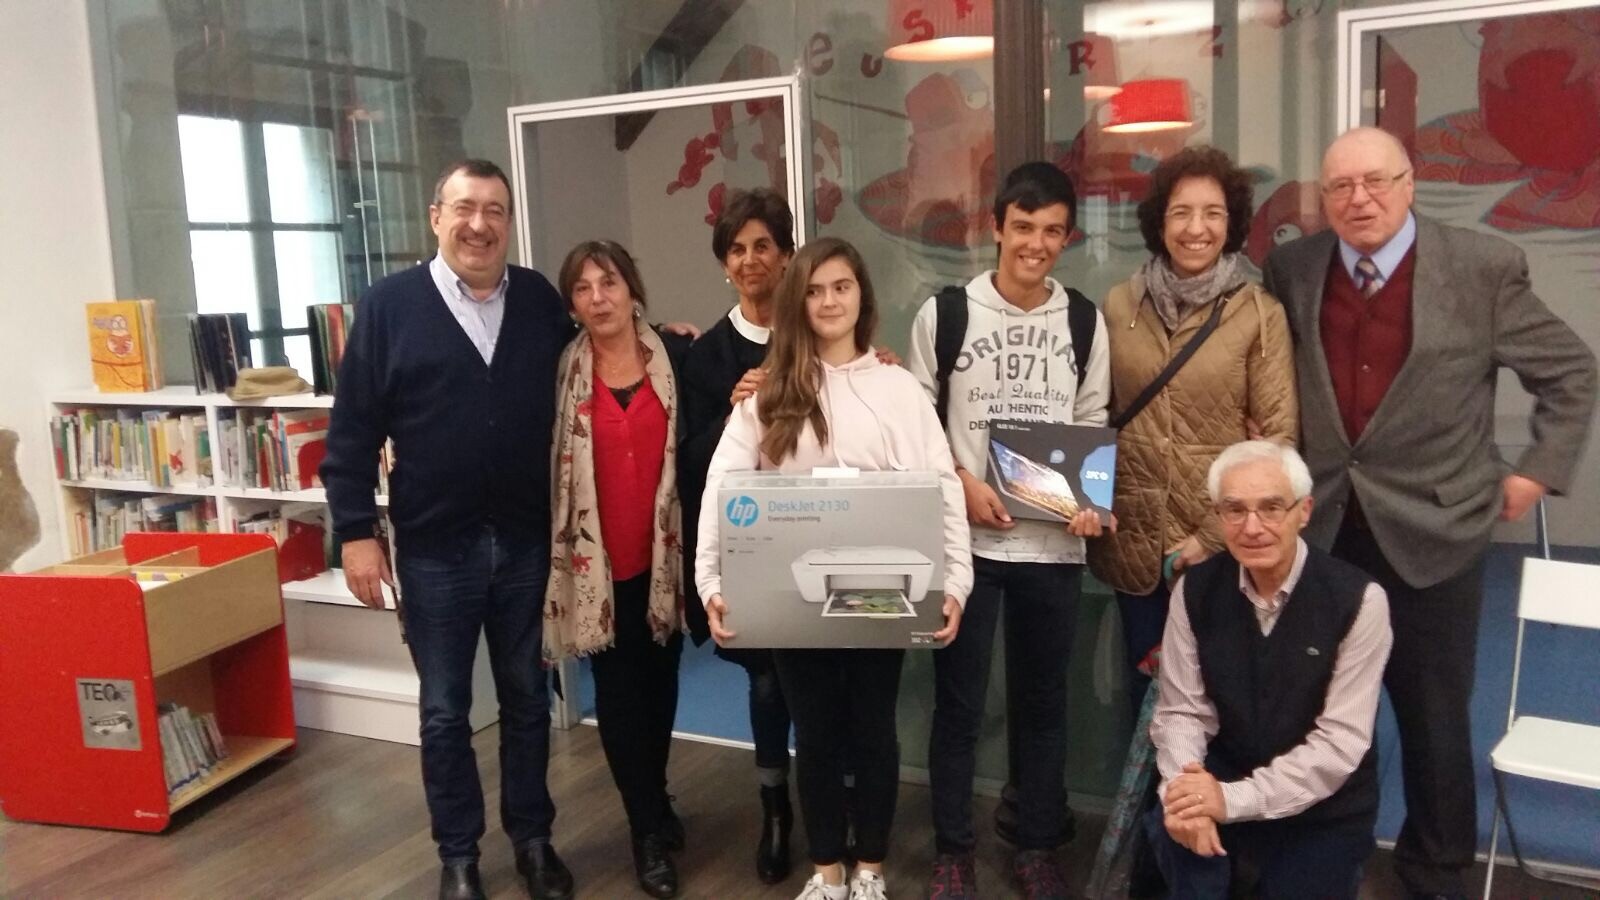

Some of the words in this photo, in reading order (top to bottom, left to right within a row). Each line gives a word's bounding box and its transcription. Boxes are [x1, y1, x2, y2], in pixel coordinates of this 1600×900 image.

[992, 353, 1048, 383] 1971
[729, 496, 757, 528] hp
[768, 500, 815, 512] DeskJet
[819, 500, 849, 512] 2130
